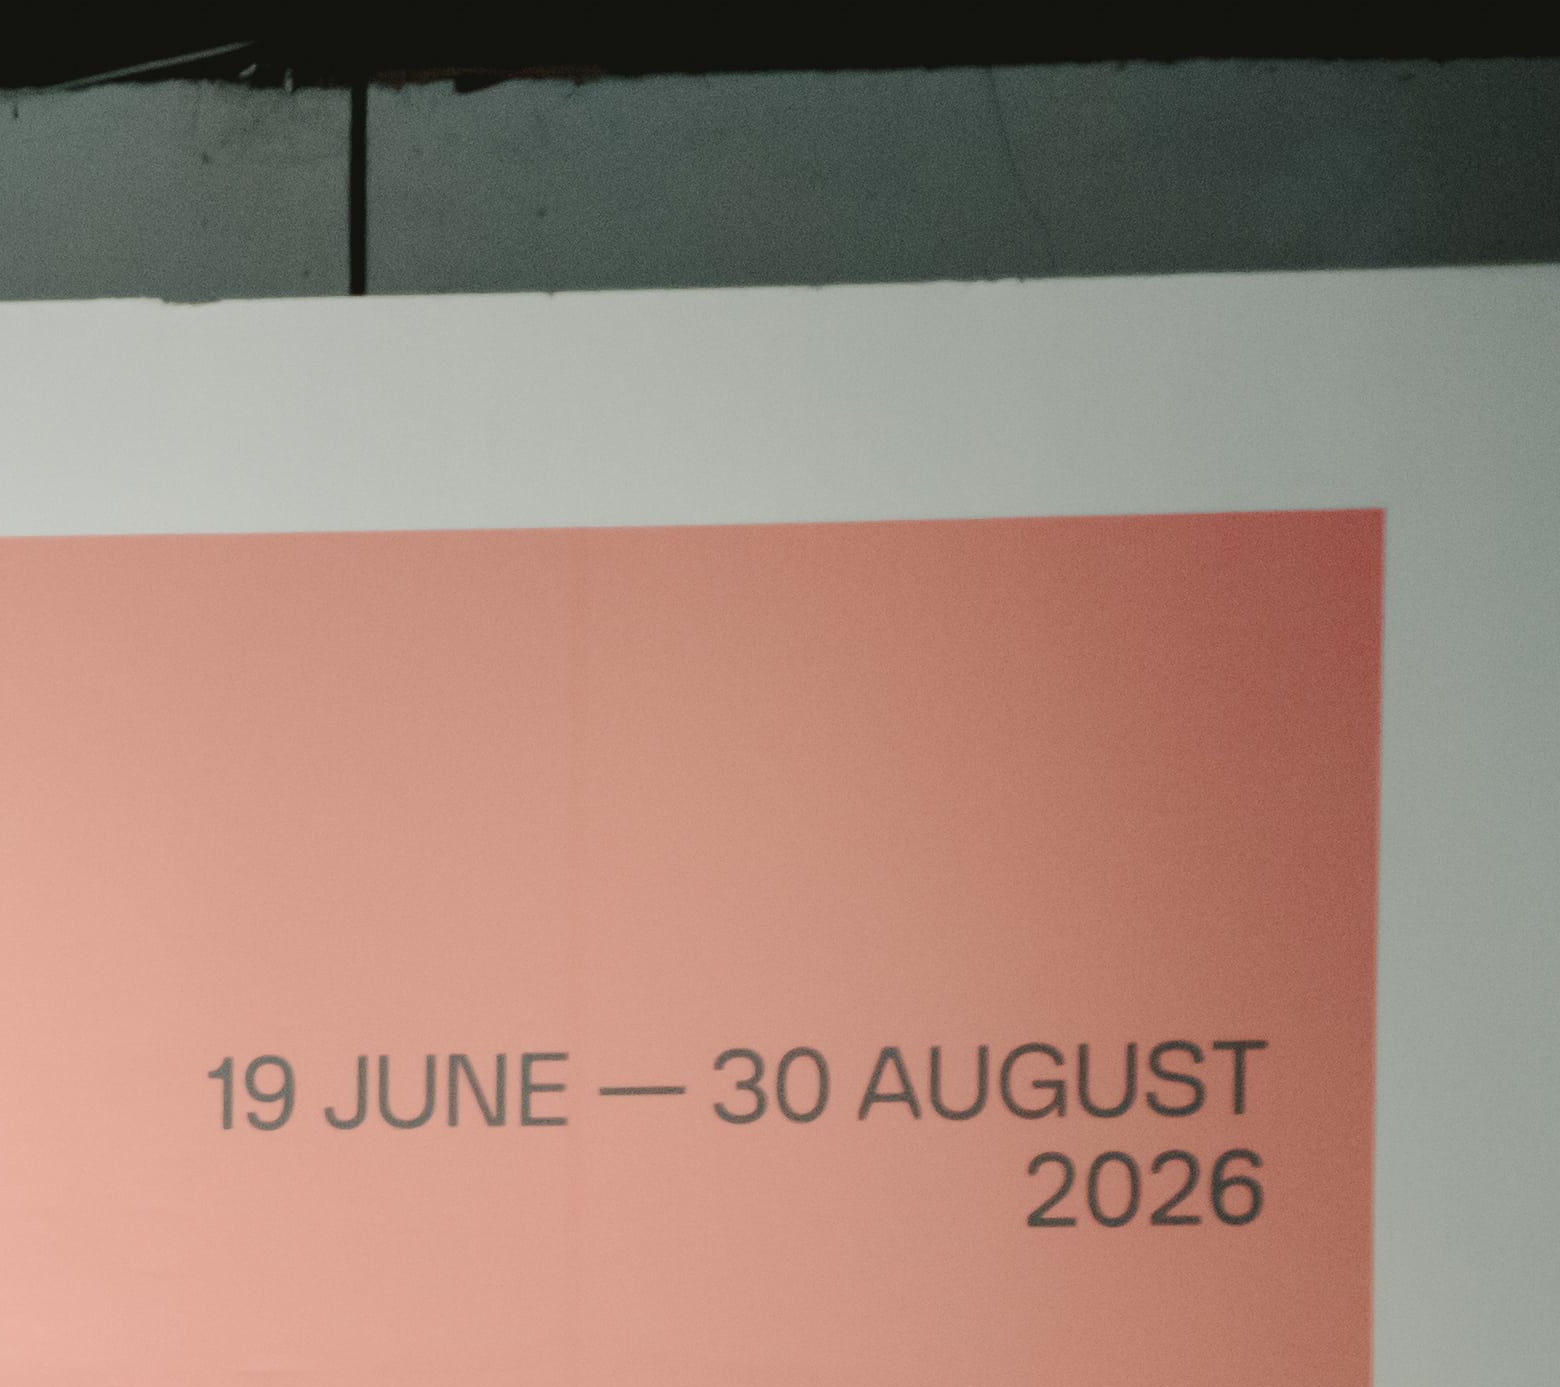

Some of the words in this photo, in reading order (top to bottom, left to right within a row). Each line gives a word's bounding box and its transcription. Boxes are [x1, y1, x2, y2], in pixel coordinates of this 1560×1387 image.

[206, 1054, 296, 1133] 19
[322, 1051, 569, 1132] JUNE
[712, 1046, 830, 1126] 30
[858, 1039, 1268, 1121] AUGUST
[1025, 1148, 1264, 1229] 2026
